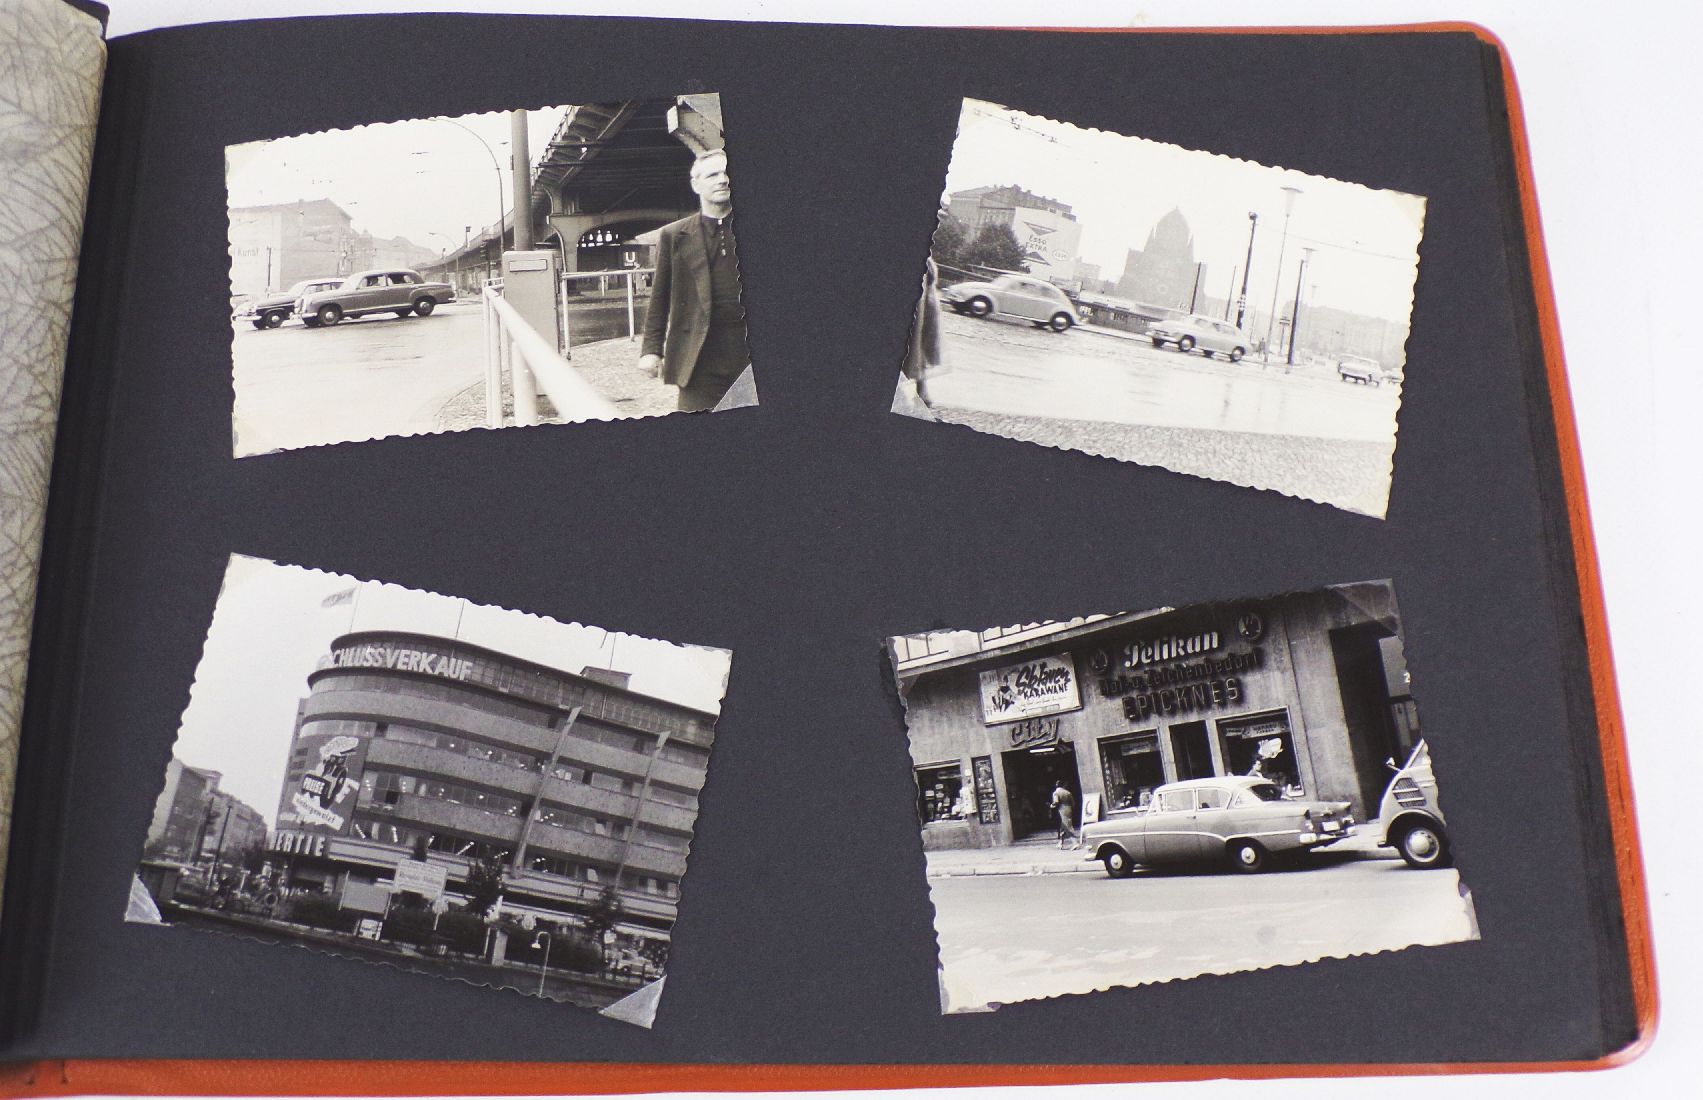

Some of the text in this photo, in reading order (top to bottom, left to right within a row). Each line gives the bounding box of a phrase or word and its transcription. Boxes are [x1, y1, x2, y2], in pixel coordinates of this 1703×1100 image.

[625, 251, 636, 263] U
[1025, 242, 1047, 251] EXTRA
[1124, 631, 1219, 668] Pelikan
[1023, 682, 1069, 700] KARAWANE
[1121, 678, 1240, 721] EPICKNES
[1011, 718, 1060, 748] City
